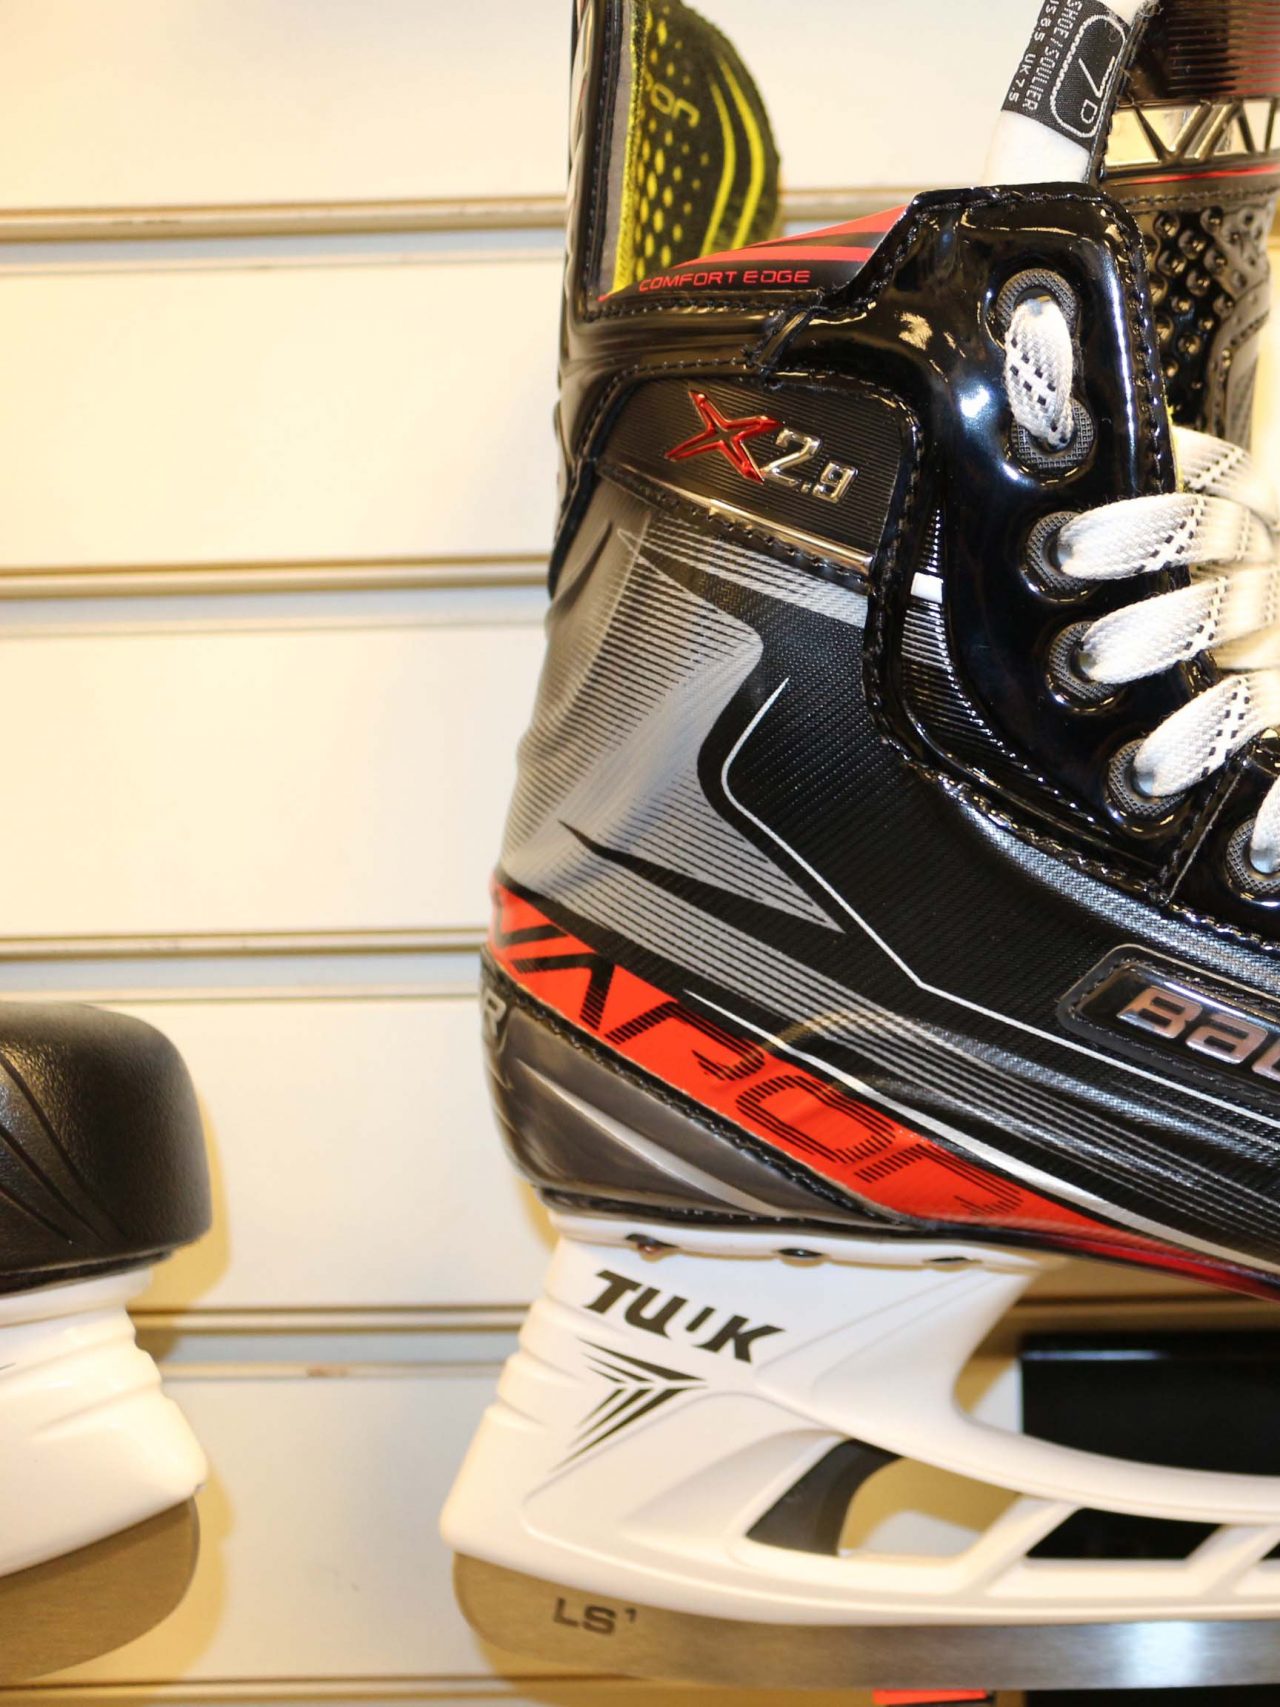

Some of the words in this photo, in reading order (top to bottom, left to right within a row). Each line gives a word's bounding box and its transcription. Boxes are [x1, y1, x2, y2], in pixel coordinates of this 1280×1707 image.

[1034, 18, 1052, 42] 8.5
[1019, 54, 1036, 75] UK
[1009, 78, 1025, 103] 7.5
[640, 271, 738, 293] COMFORT
[743, 270, 811, 284] EDGE
